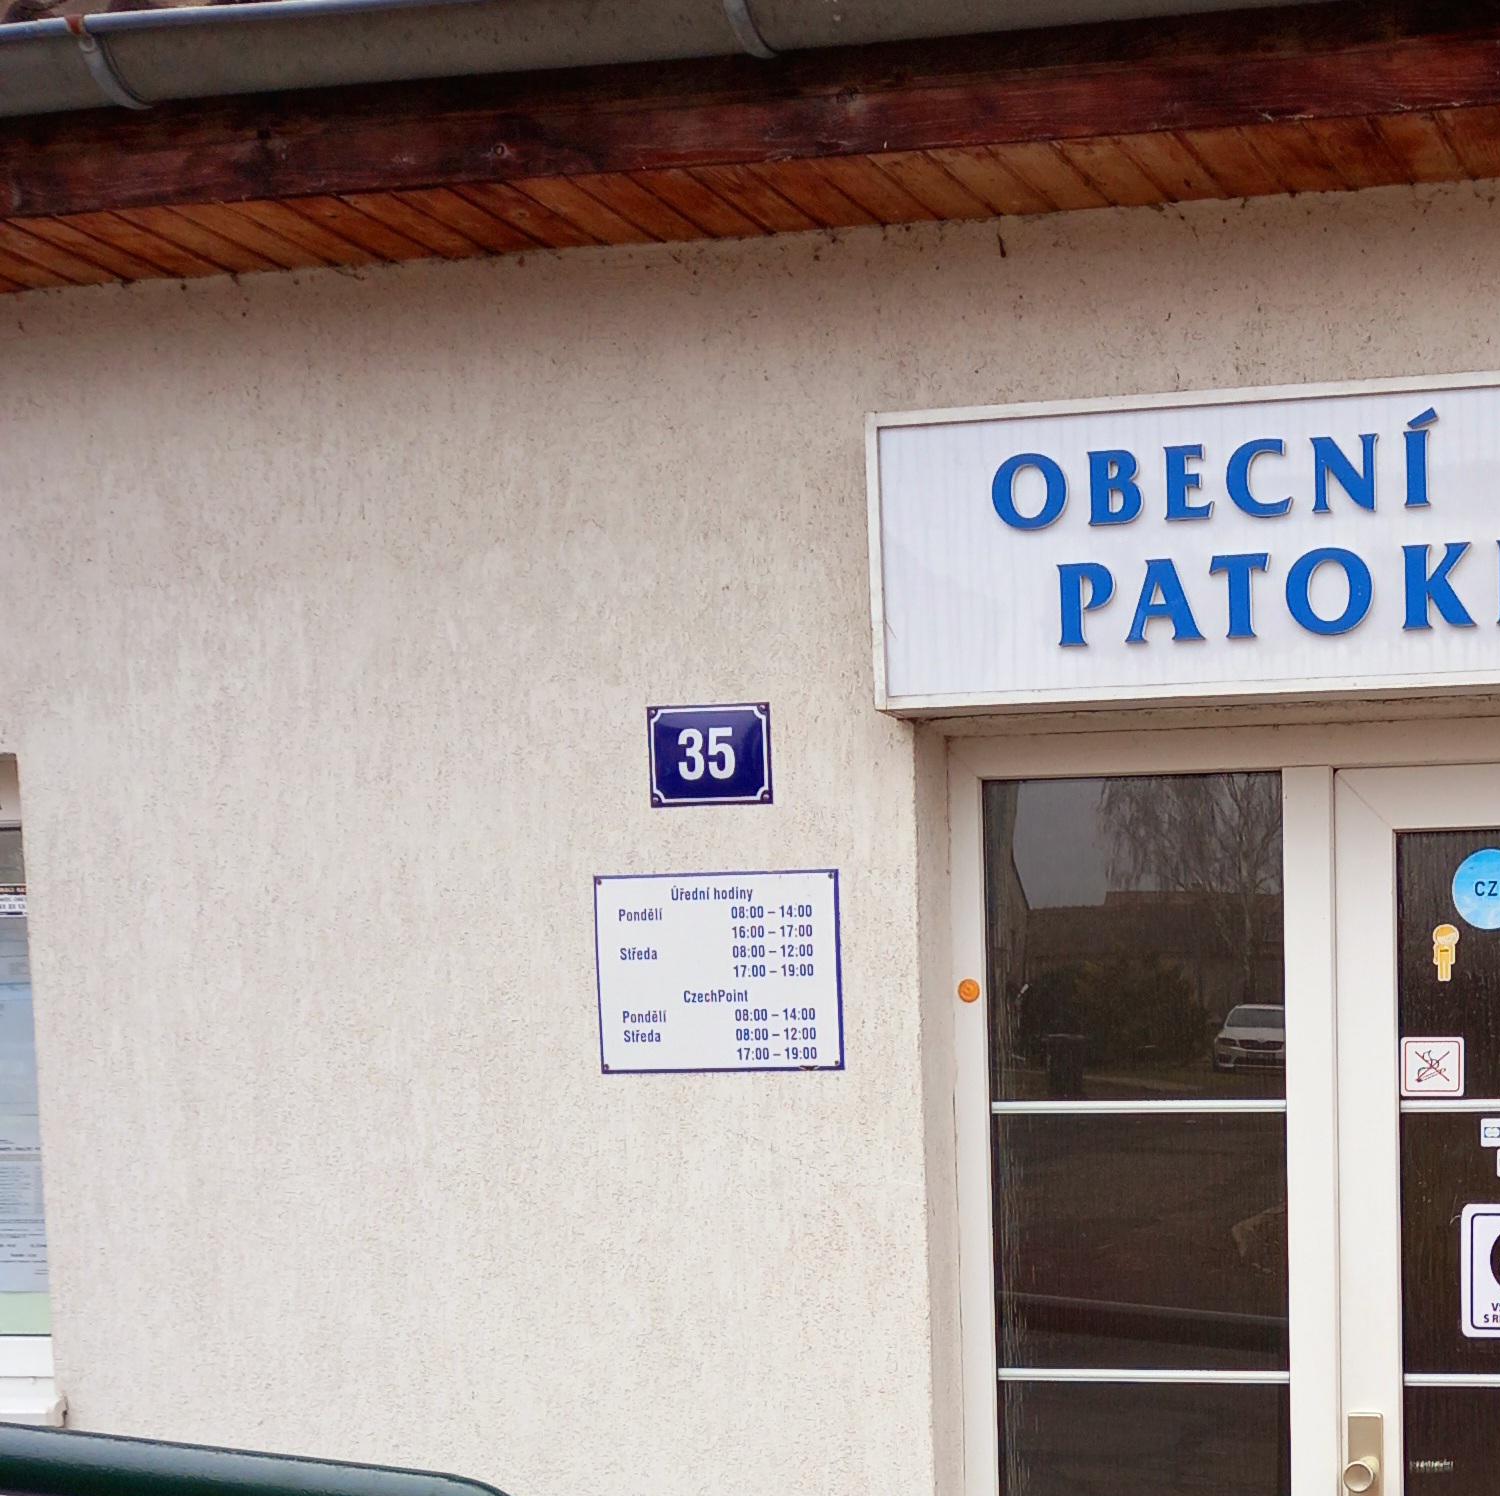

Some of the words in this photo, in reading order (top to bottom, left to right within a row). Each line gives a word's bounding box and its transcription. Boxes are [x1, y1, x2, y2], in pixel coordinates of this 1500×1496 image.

[991, 409, 1436, 530] OBECNÍ
[677, 726, 736, 781] 35
[670, 885, 710, 902] Úřední
[713, 886, 754, 902] hodiny
[618, 907, 663, 922] Pondělí
[730, 905, 764, 920] 08:00
[779, 904, 813, 918] 14:00
[731, 925, 765, 939] 16:00
[779, 923, 813, 938] 17:00
[619, 946, 658, 961] Středa
[732, 944, 766, 959] 08:00
[779, 943, 814, 957] 12:00
[733, 964, 766, 978] 17:00
[780, 963, 814, 977] 19:00
[683, 988, 749, 1003] CzechPoint
[622, 1009, 667, 1024] Pondělí
[734, 1008, 768, 1022] 08:00
[782, 1007, 816, 1021] 14:00
[623, 1028, 662, 1043] Středa
[735, 1027, 769, 1041] 08:00
[783, 1026, 817, 1041] 12:00
[736, 1047, 770, 1061] 17:00
[784, 1046, 818, 1060] 19:00
[1483, 1313, 1490, 1324] S
